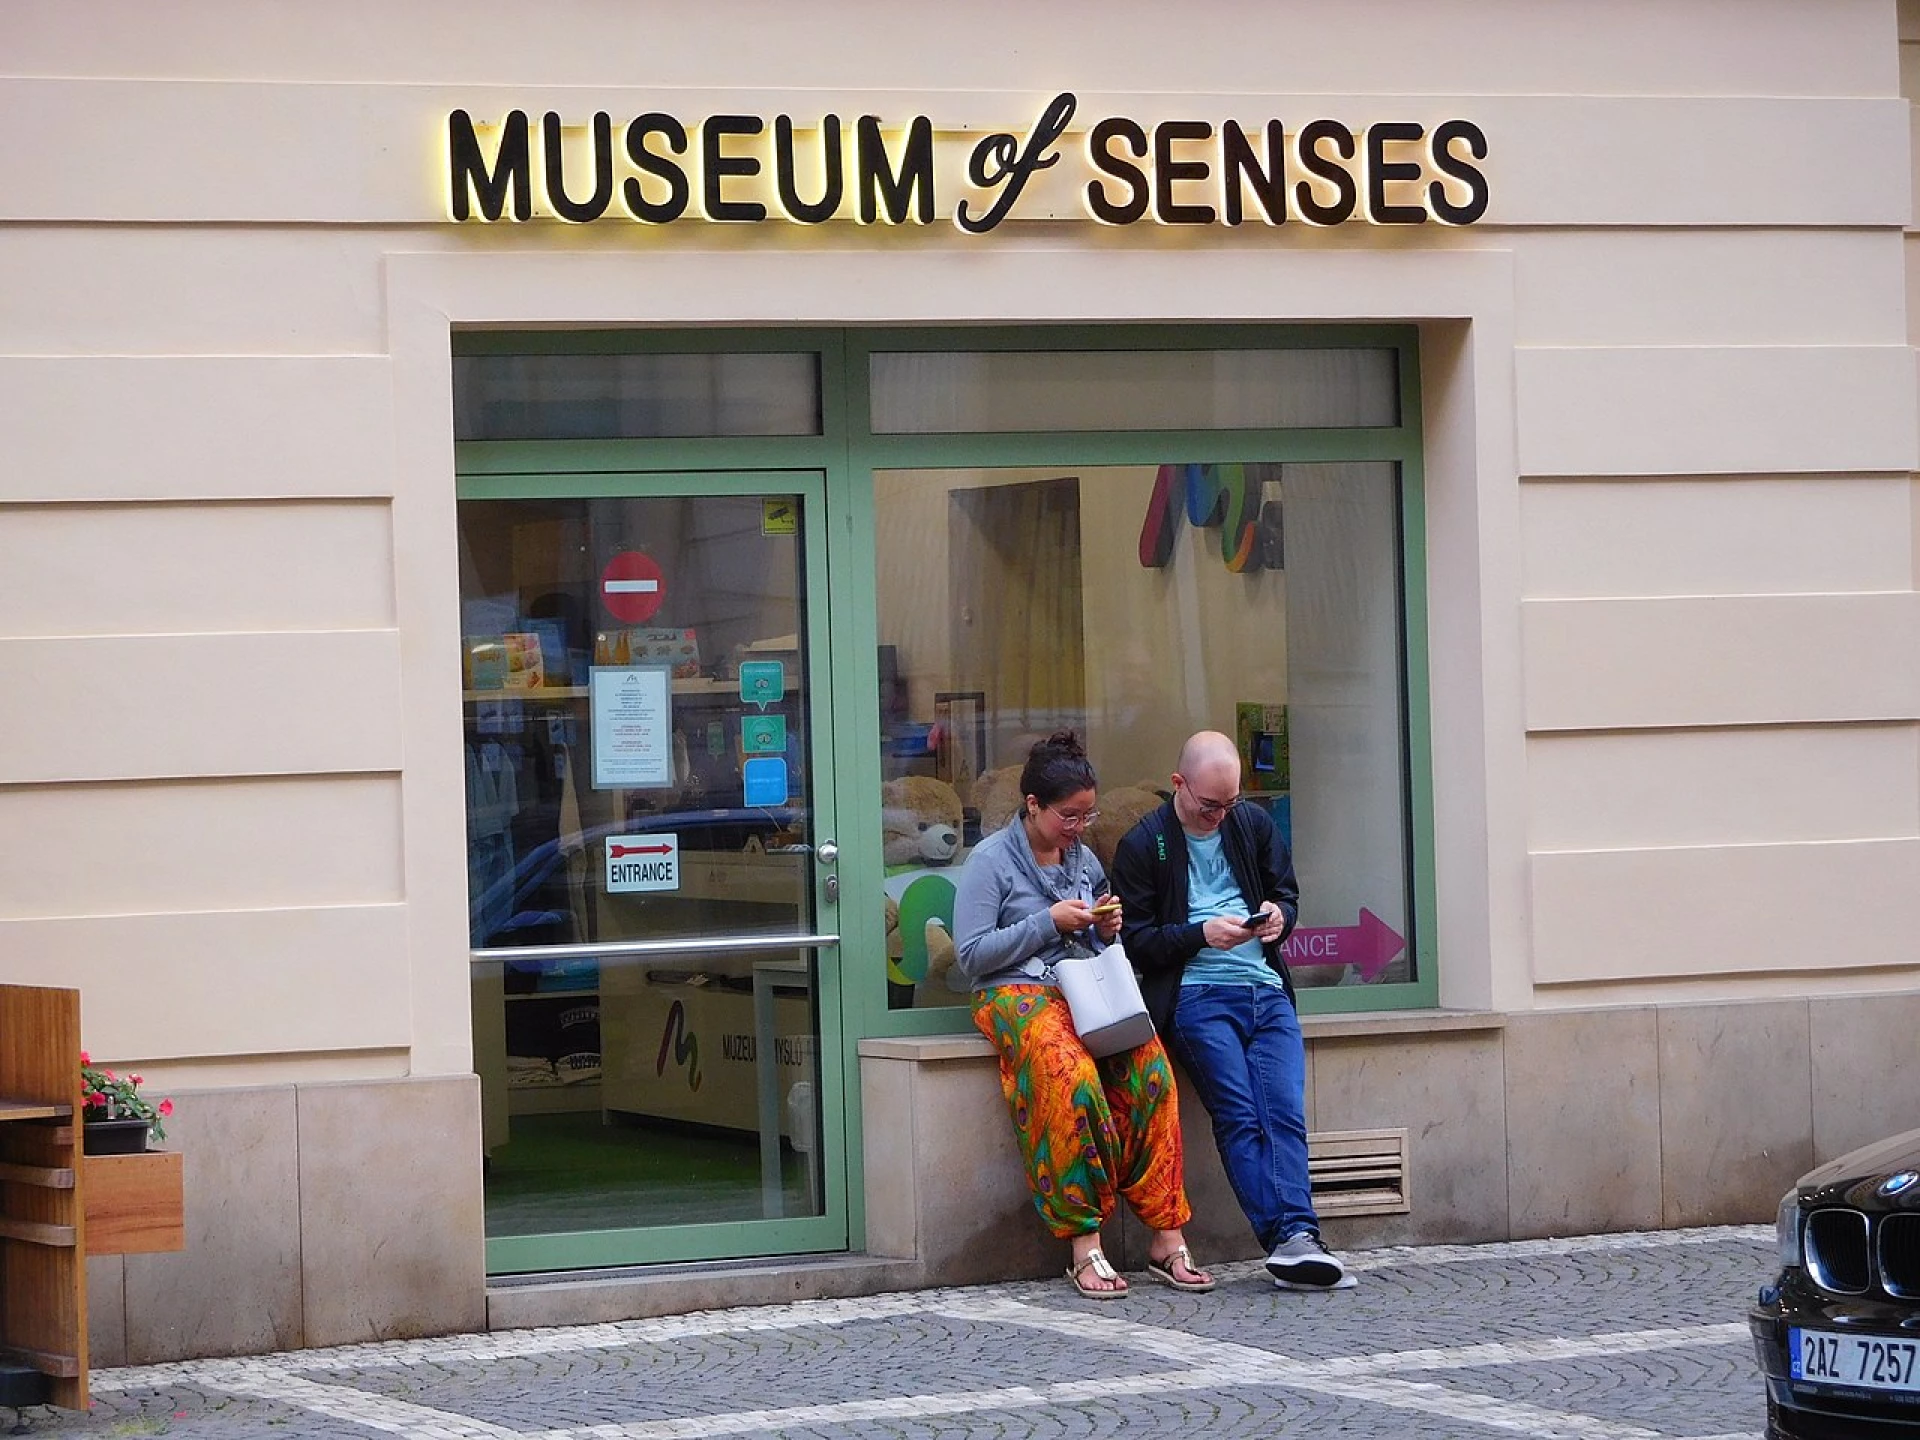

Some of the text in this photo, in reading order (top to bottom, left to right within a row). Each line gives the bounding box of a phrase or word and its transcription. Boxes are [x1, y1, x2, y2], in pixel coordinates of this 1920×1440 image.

[449, 92, 1489, 233] MUSEUM of SENSES
[611, 862, 673, 883] ENTRANCE
[1279, 933, 1339, 958] ANCE
[722, 1034, 757, 1063] MUZEU
[1805, 1336, 1916, 1384] 2AZ 7257
